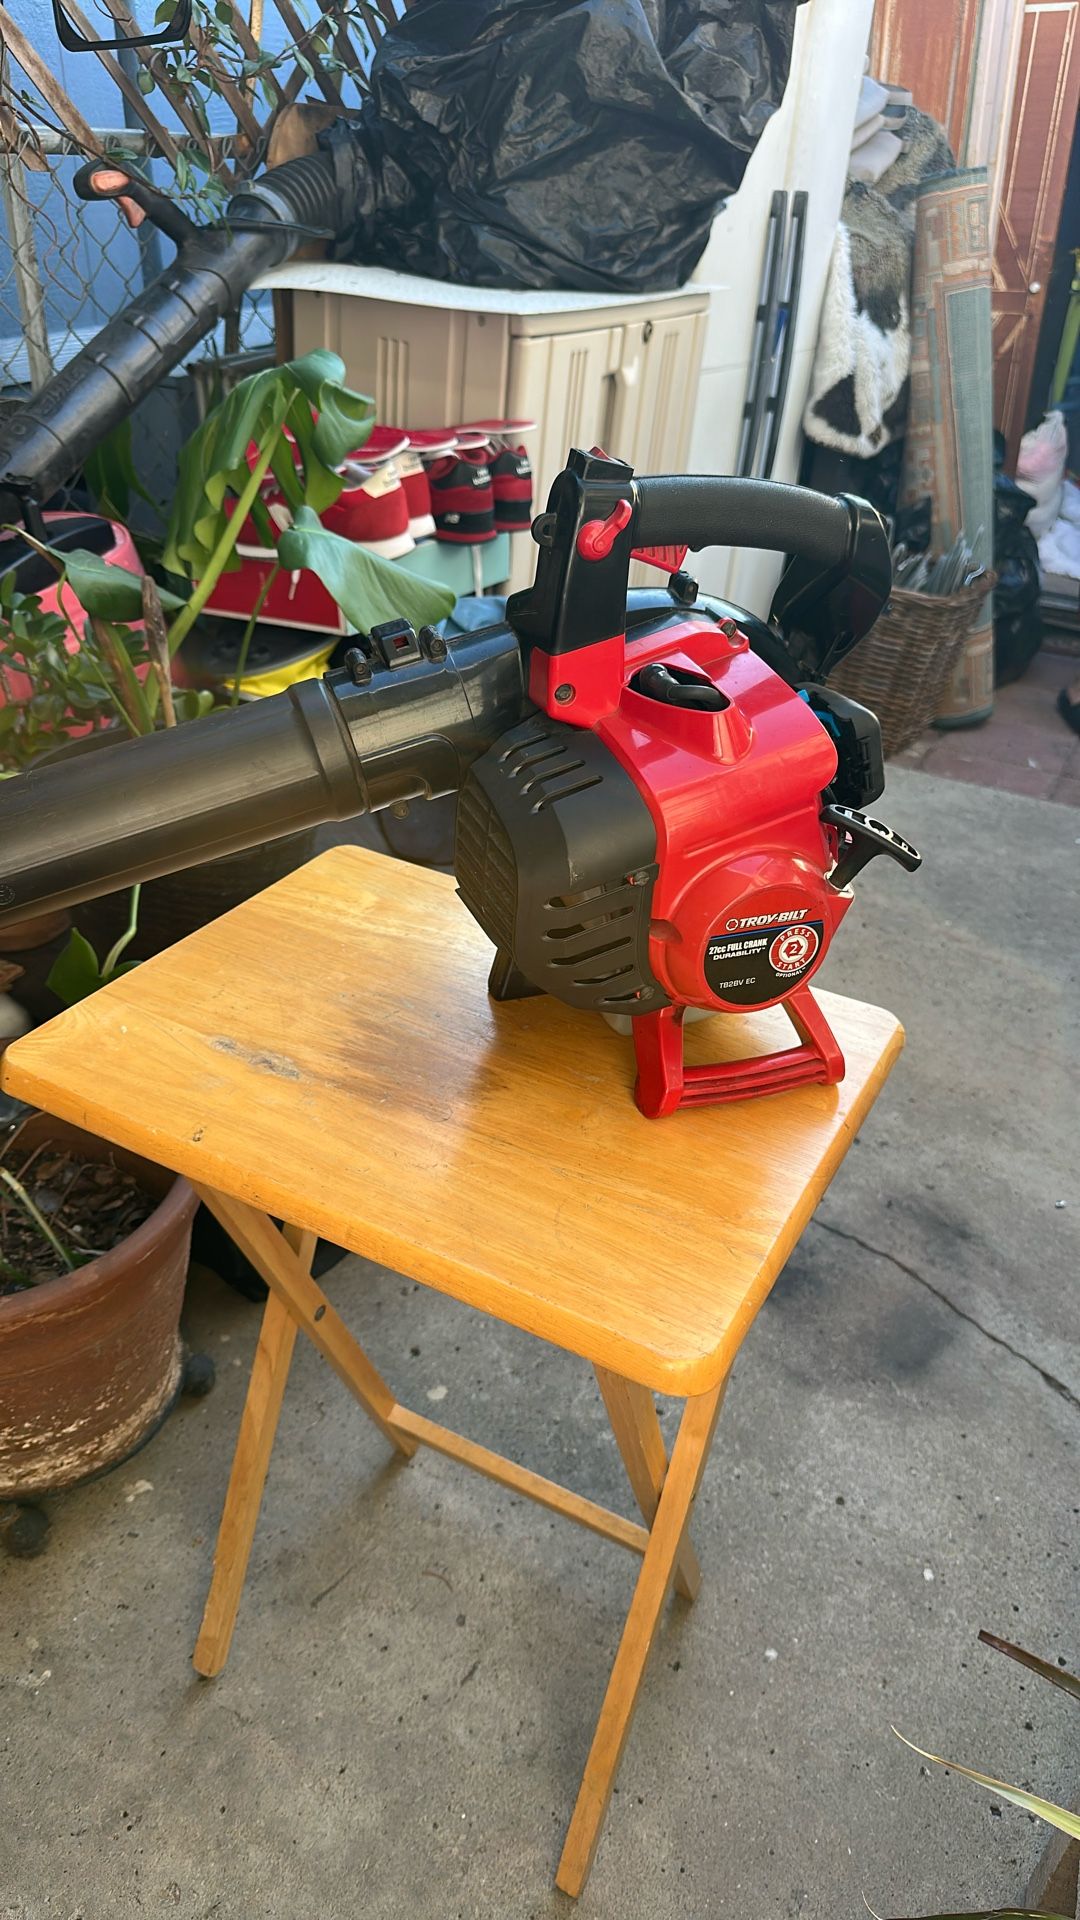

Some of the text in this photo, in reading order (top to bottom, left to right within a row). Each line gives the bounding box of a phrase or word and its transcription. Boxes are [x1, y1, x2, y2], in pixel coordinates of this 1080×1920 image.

[739, 909, 808, 928] TROY-BILT
[780, 928, 811, 941] PRESS
[708, 938, 768, 955] 27cc FULL CRANK
[789, 943, 799, 954] 2
[776, 958, 806, 970] START
[745, 977, 756, 985] EC
